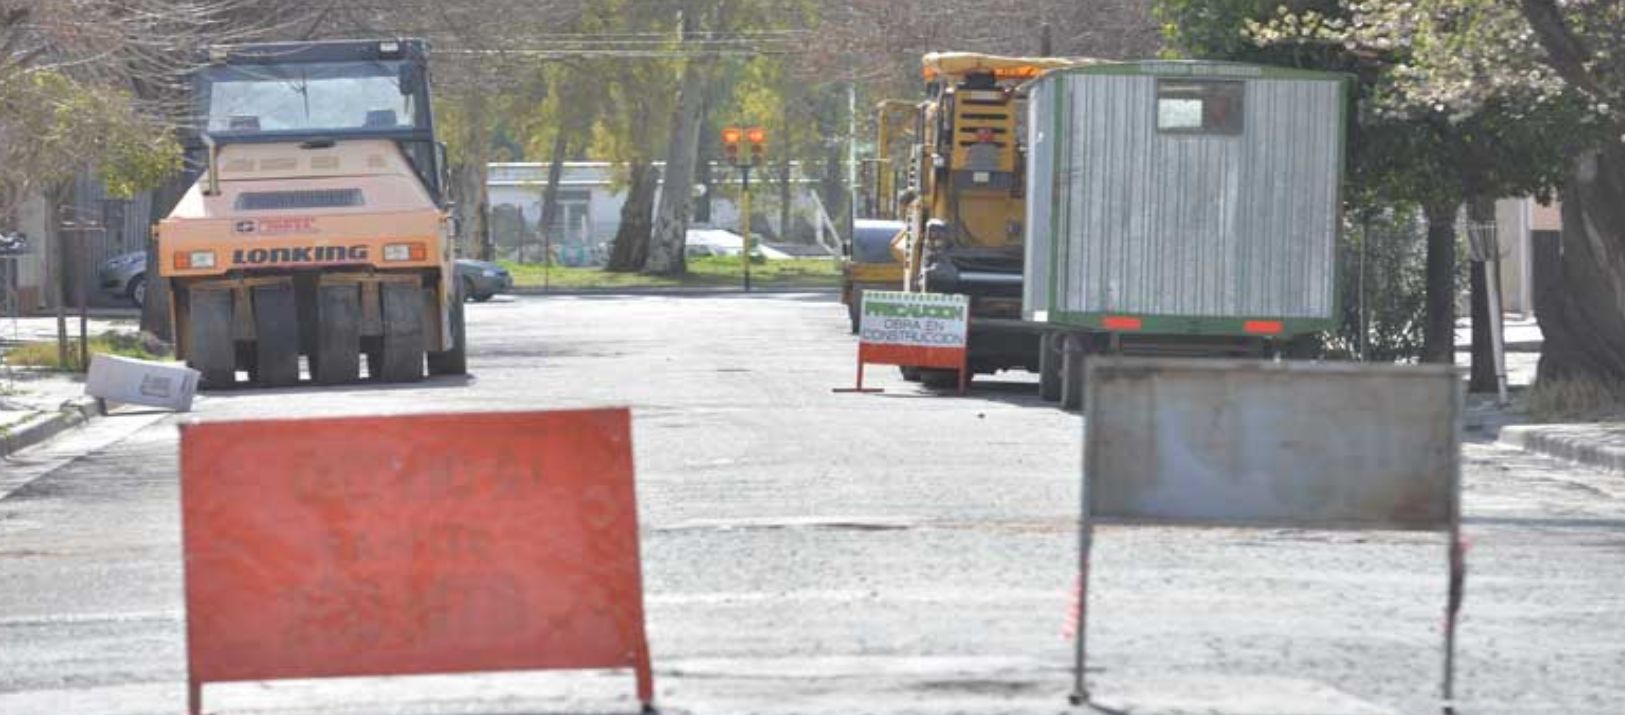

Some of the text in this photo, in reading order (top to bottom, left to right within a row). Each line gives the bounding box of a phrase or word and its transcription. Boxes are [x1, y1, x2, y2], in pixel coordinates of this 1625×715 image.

[232, 244, 370, 264] LONKING
[884, 319, 945, 331] OBRA EN
